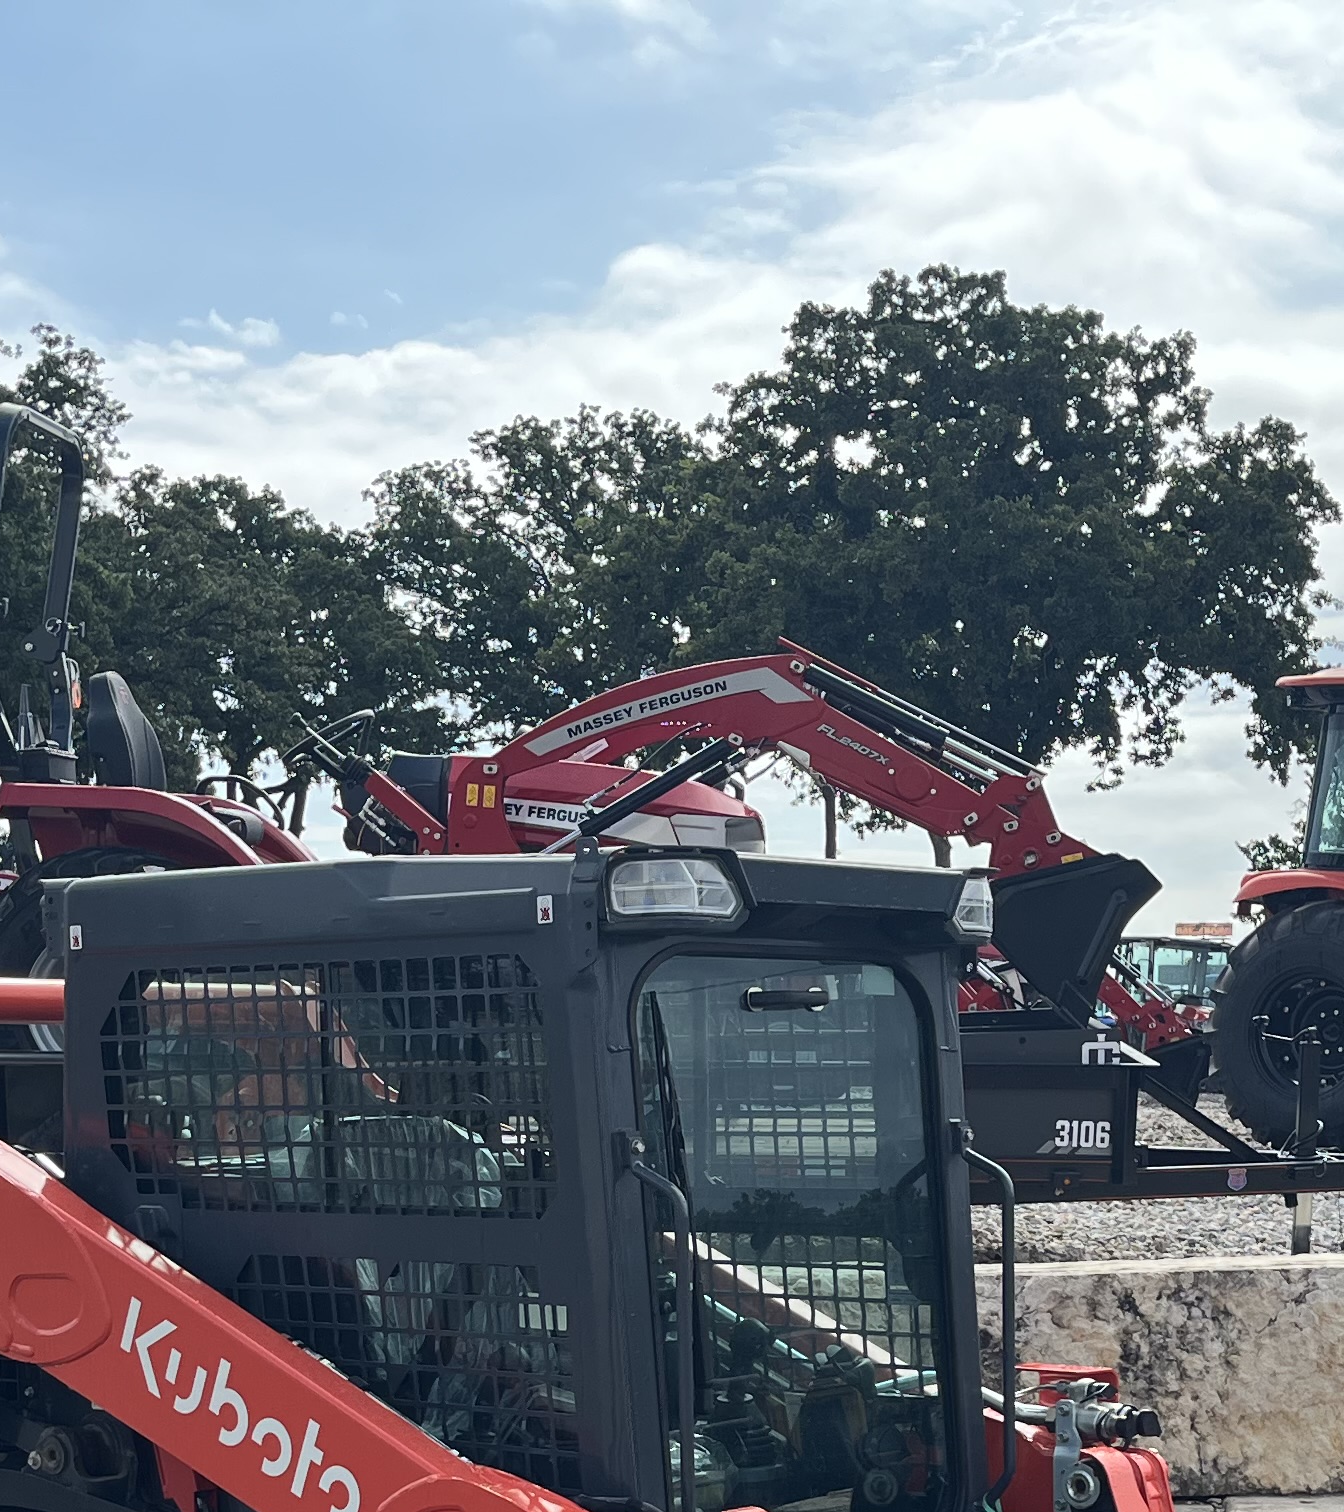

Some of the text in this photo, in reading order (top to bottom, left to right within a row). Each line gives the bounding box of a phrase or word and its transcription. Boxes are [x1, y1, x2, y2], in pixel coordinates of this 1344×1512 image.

[567, 680, 728, 738] MASSEY FERGUSON
[527, 805, 588, 823] FERGUS
[1054, 1119, 1111, 1148] 3106
